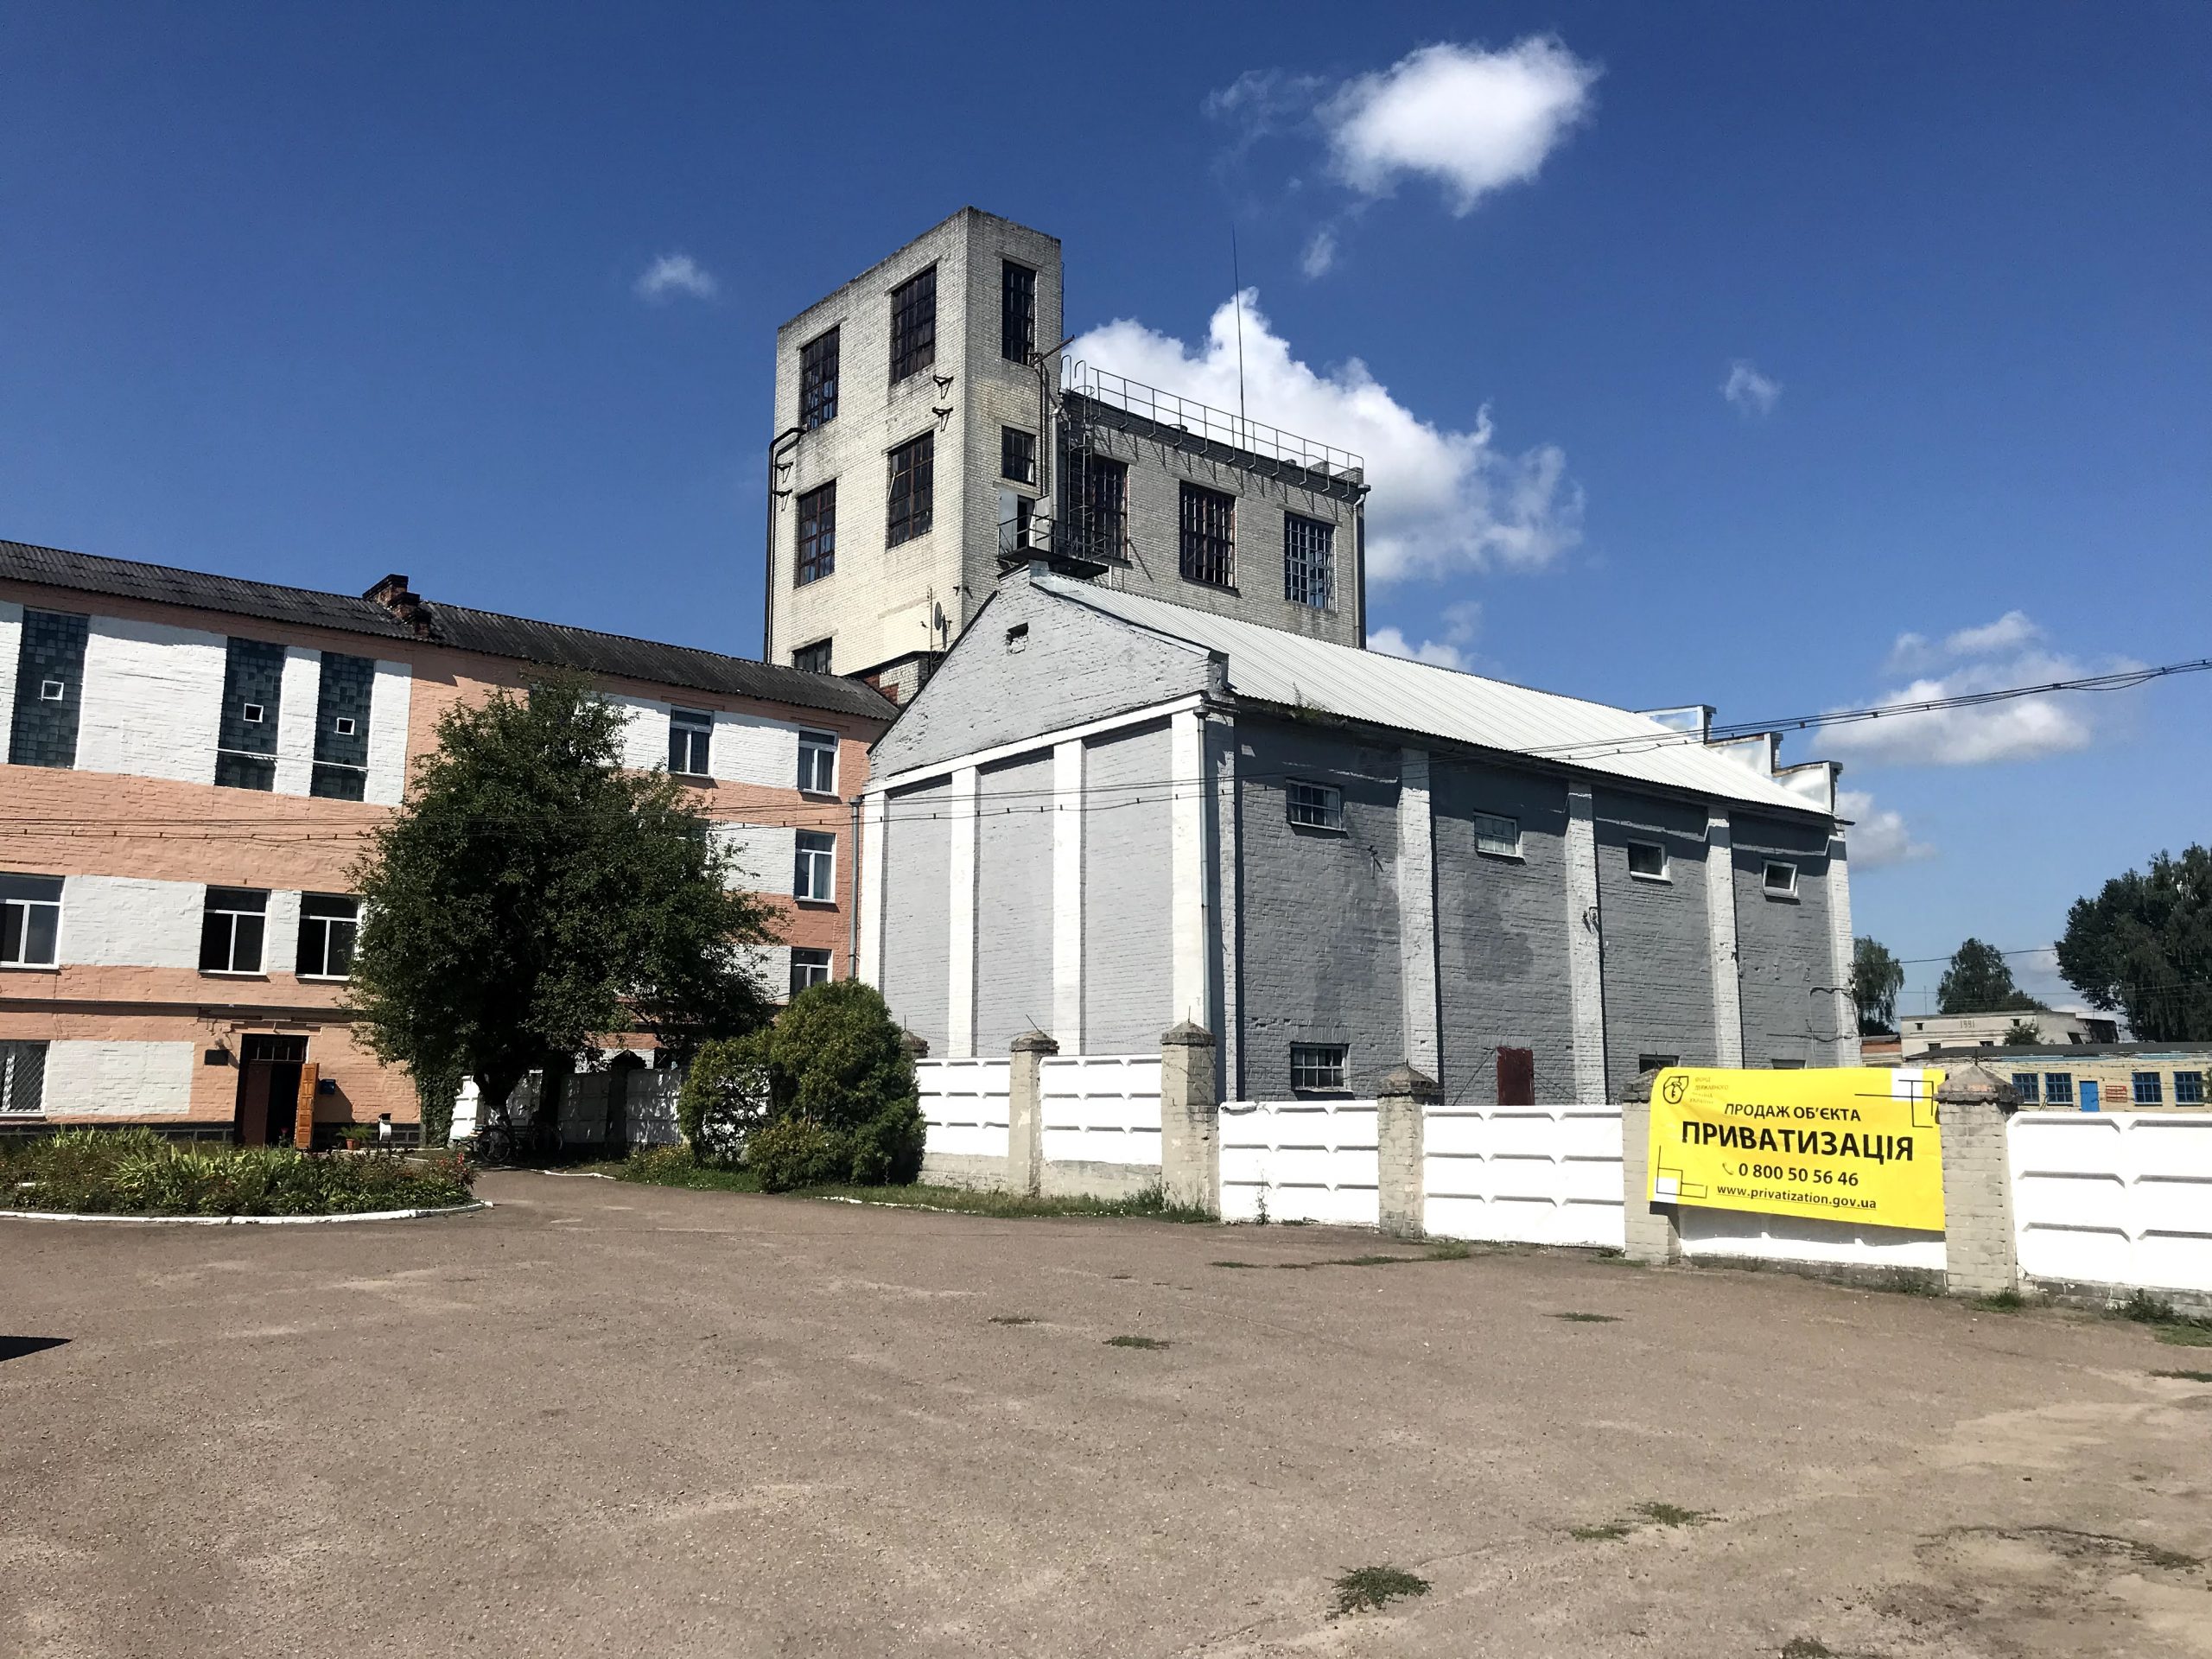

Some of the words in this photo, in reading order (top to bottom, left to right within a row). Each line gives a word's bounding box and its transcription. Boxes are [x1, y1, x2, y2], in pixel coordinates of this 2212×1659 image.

[1960, 1020, 1975, 1028] 1991
[1724, 1103, 1790, 1119] ПРОДАЖ
[1793, 1106, 1861, 1122] ОБ’ЄКТА
[1681, 1121, 1914, 1165] ПРИВАТИЗАЦІЯ
[1738, 1162, 1749, 1176] 0
[1752, 1164, 1783, 1179] 800
[1788, 1167, 1808, 1182] 50
[1813, 1169, 1834, 1184] 56
[1837, 1172, 1859, 1186] 46
[1716, 1185, 1877, 1209] www.privatization.gov.ua
